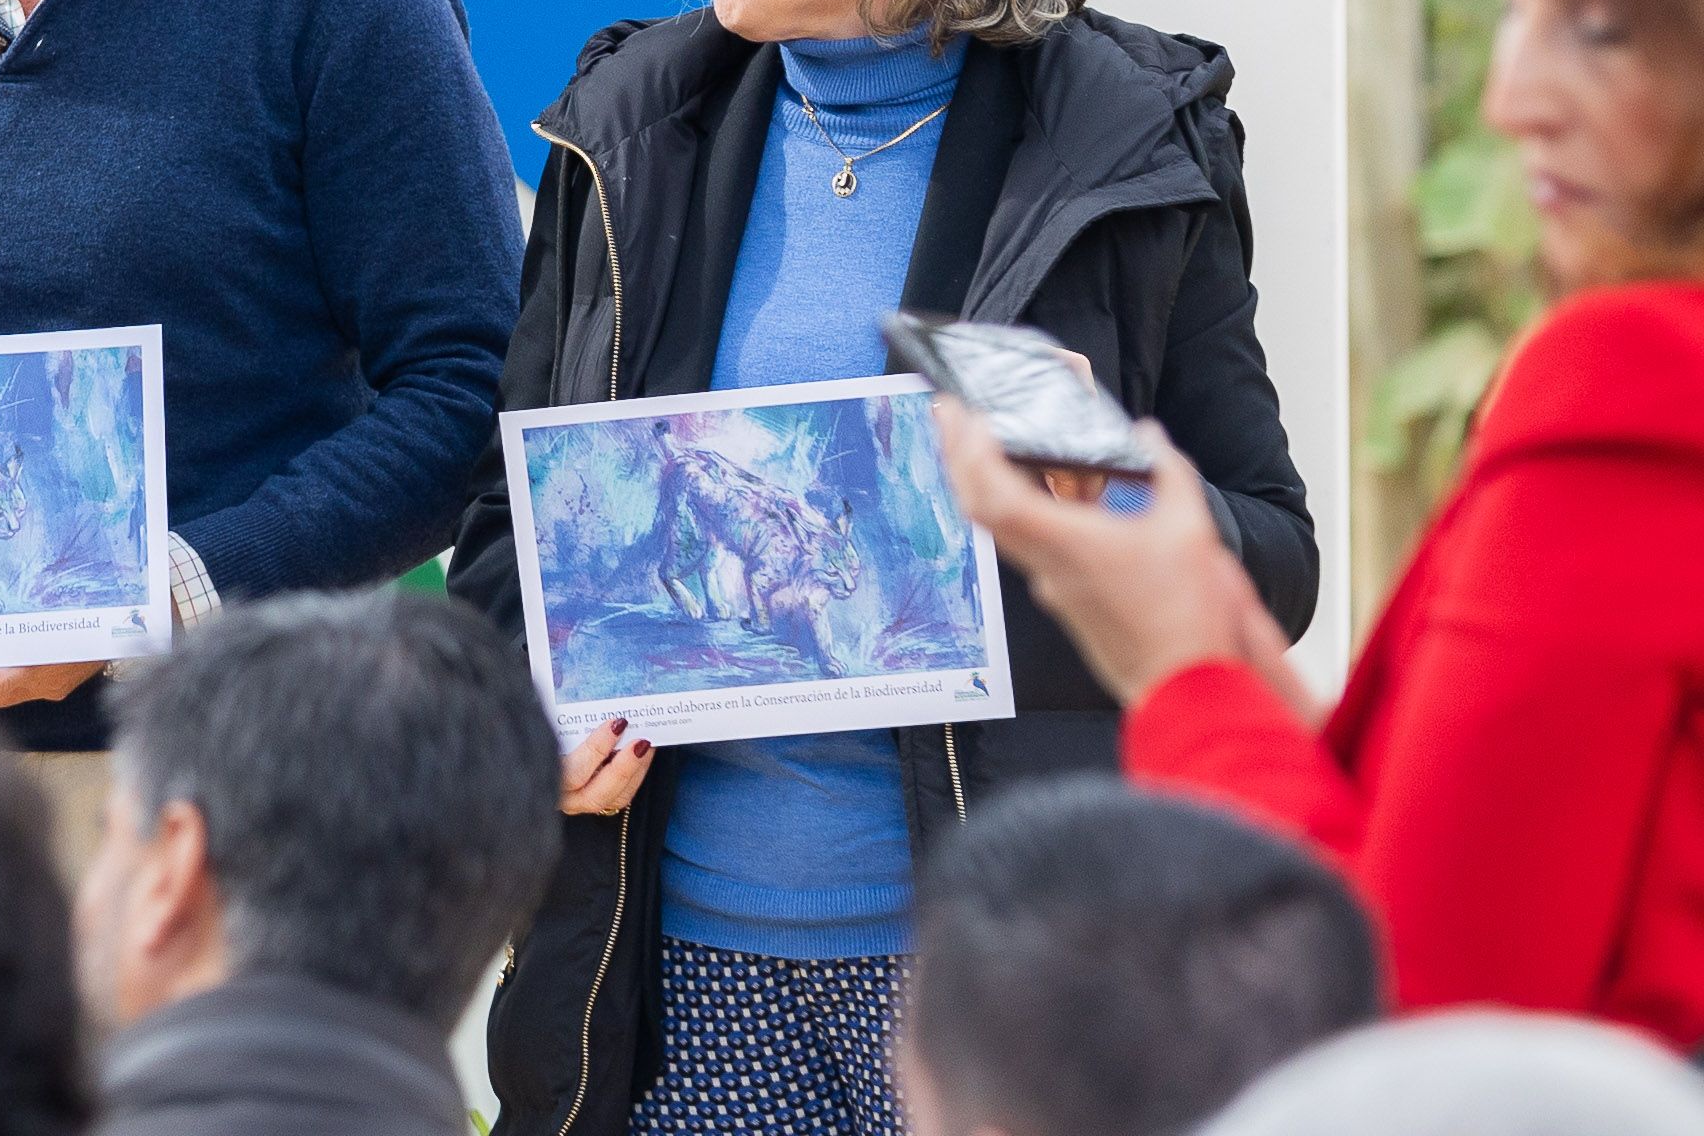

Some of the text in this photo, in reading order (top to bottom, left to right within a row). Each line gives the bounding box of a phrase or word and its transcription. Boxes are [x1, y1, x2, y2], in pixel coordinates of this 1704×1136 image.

[4, 622, 16, 635] la
[18, 616, 101, 634] Biodiversidad
[557, 713, 582, 726] Con
[585, 712, 598, 722] tu
[667, 698, 723, 716] colaboras
[724, 700, 739, 711] en
[741, 695, 752, 708] la
[754, 689, 832, 707] Conservación
[834, 687, 848, 700] de
[849, 686, 861, 699] la
[864, 679, 944, 697] Biodiversidad
